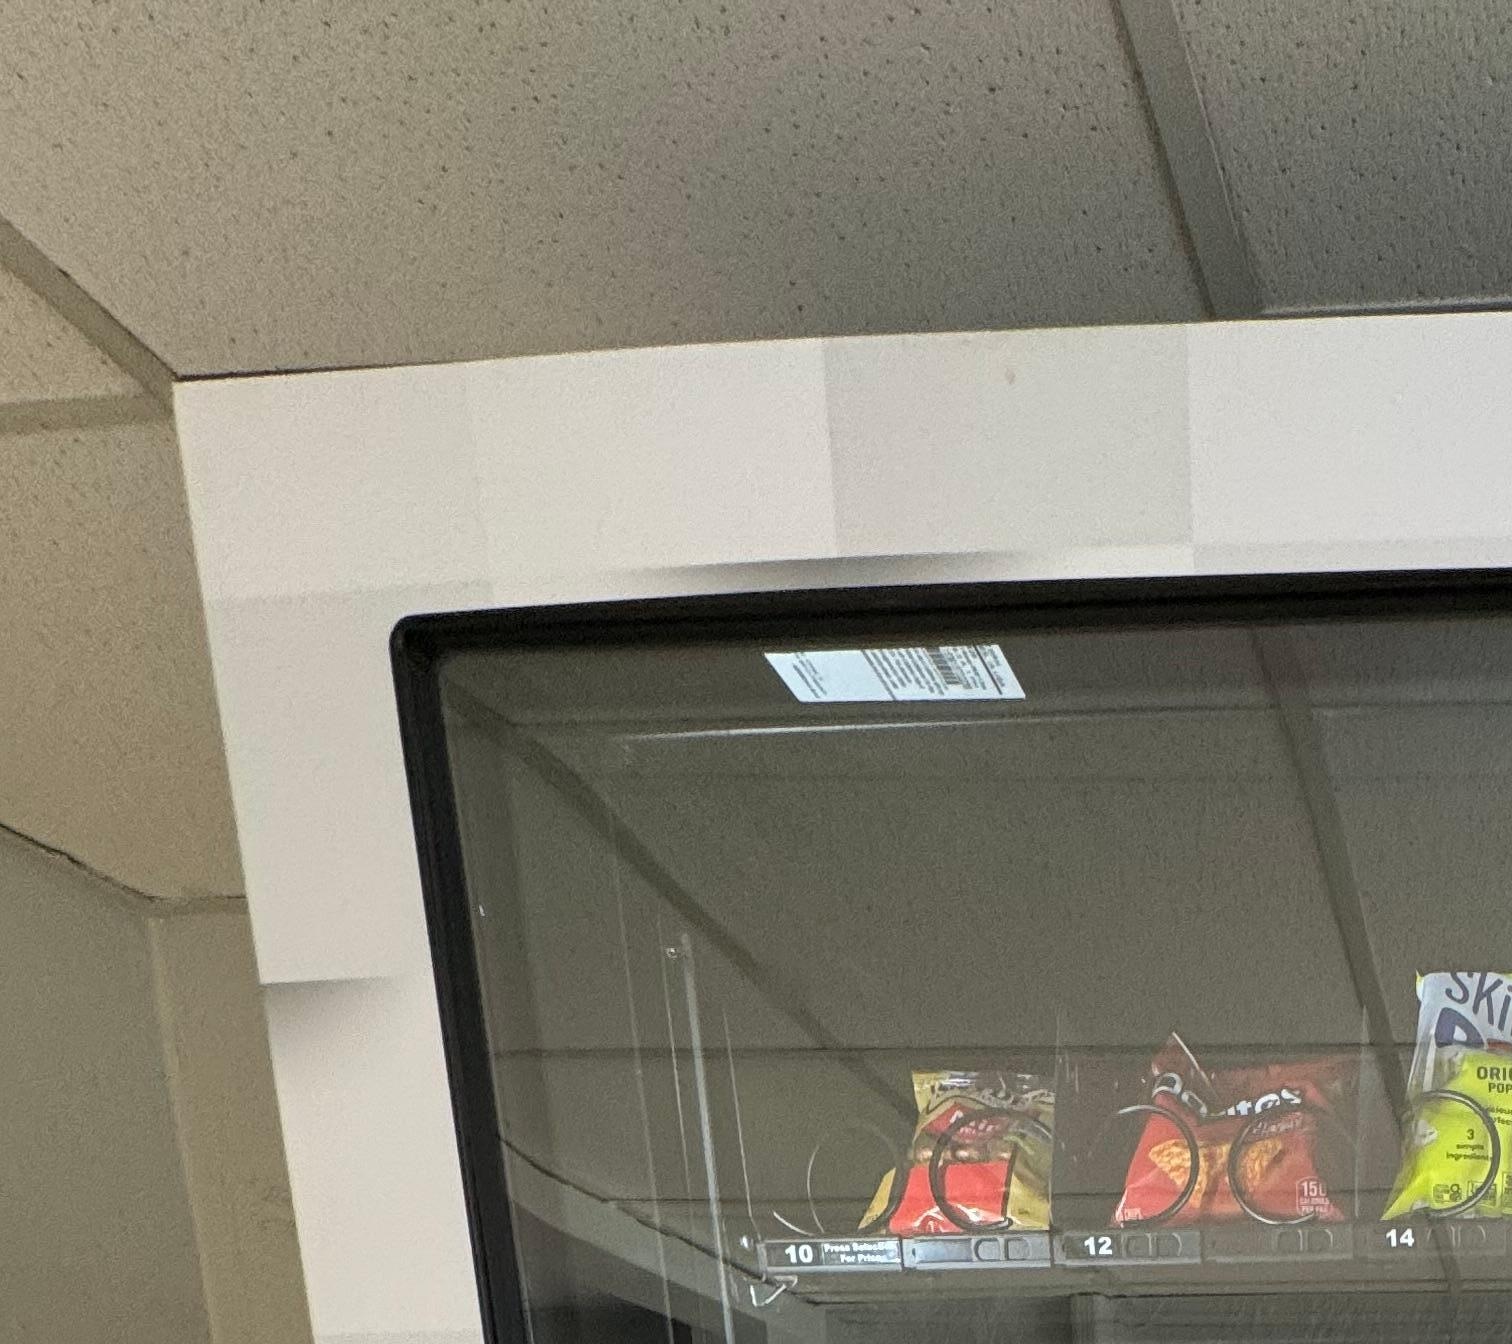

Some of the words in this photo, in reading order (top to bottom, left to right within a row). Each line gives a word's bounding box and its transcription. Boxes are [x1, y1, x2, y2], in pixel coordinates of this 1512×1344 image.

[1466, 1128, 1475, 1140] 3
[1084, 1236, 1113, 1256] 12
[1385, 1227, 1415, 1247] 14
[785, 1244, 813, 1264] 10
